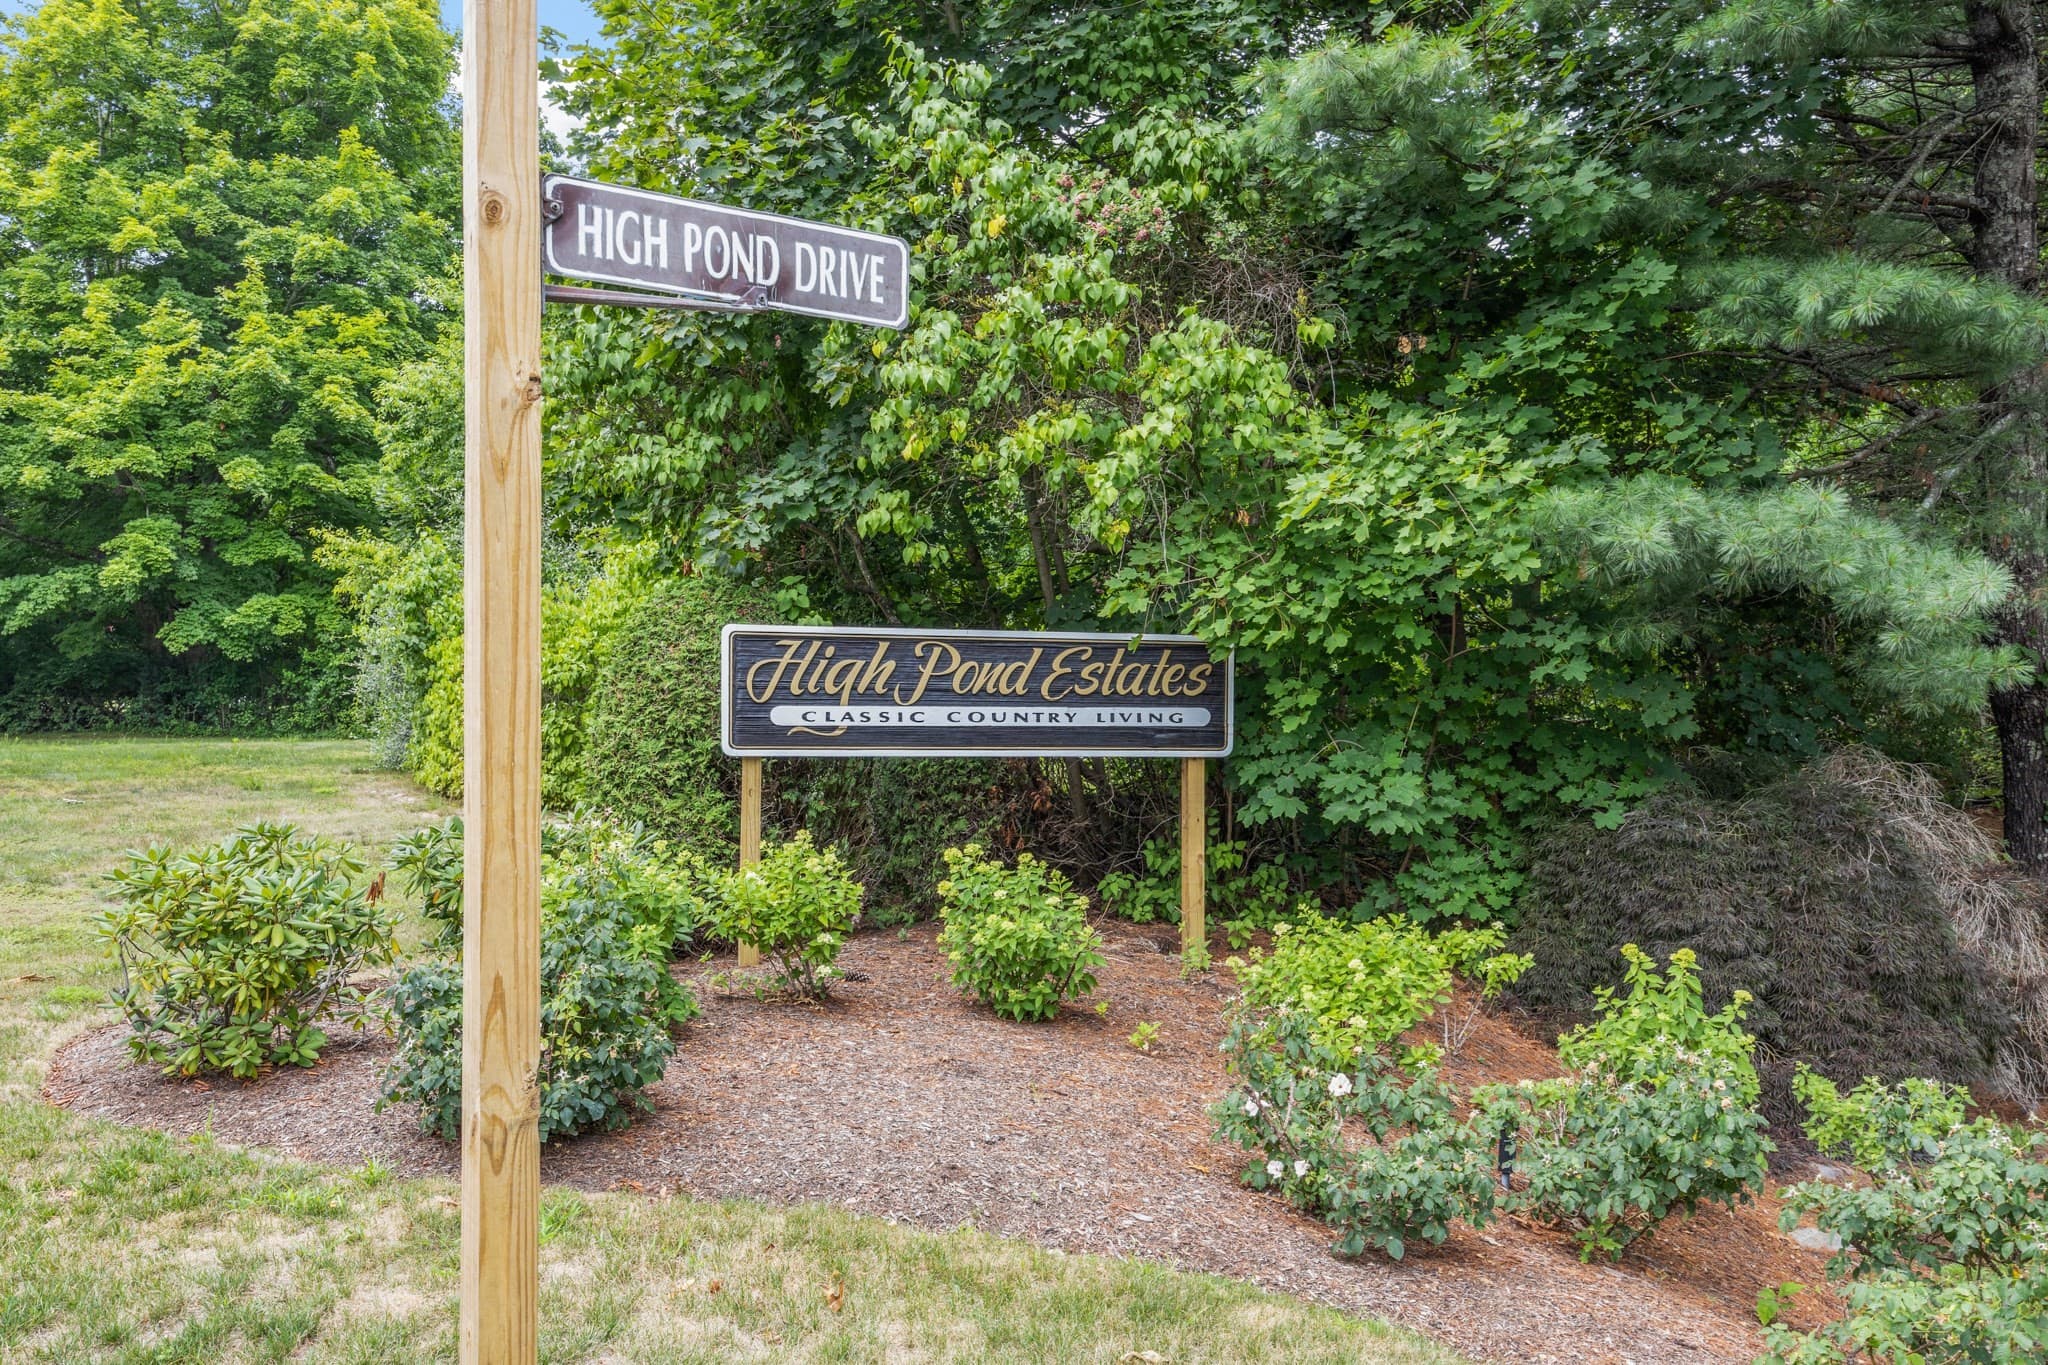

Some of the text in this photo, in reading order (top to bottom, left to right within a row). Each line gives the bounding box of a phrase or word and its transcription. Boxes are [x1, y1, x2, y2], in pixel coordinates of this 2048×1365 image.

[578, 203, 885, 304] HIGH POND DRIVE
[746, 639, 1213, 737] High Pond Estates
[801, 711, 1185, 724] CLASSIC COUNTRY LIVING
